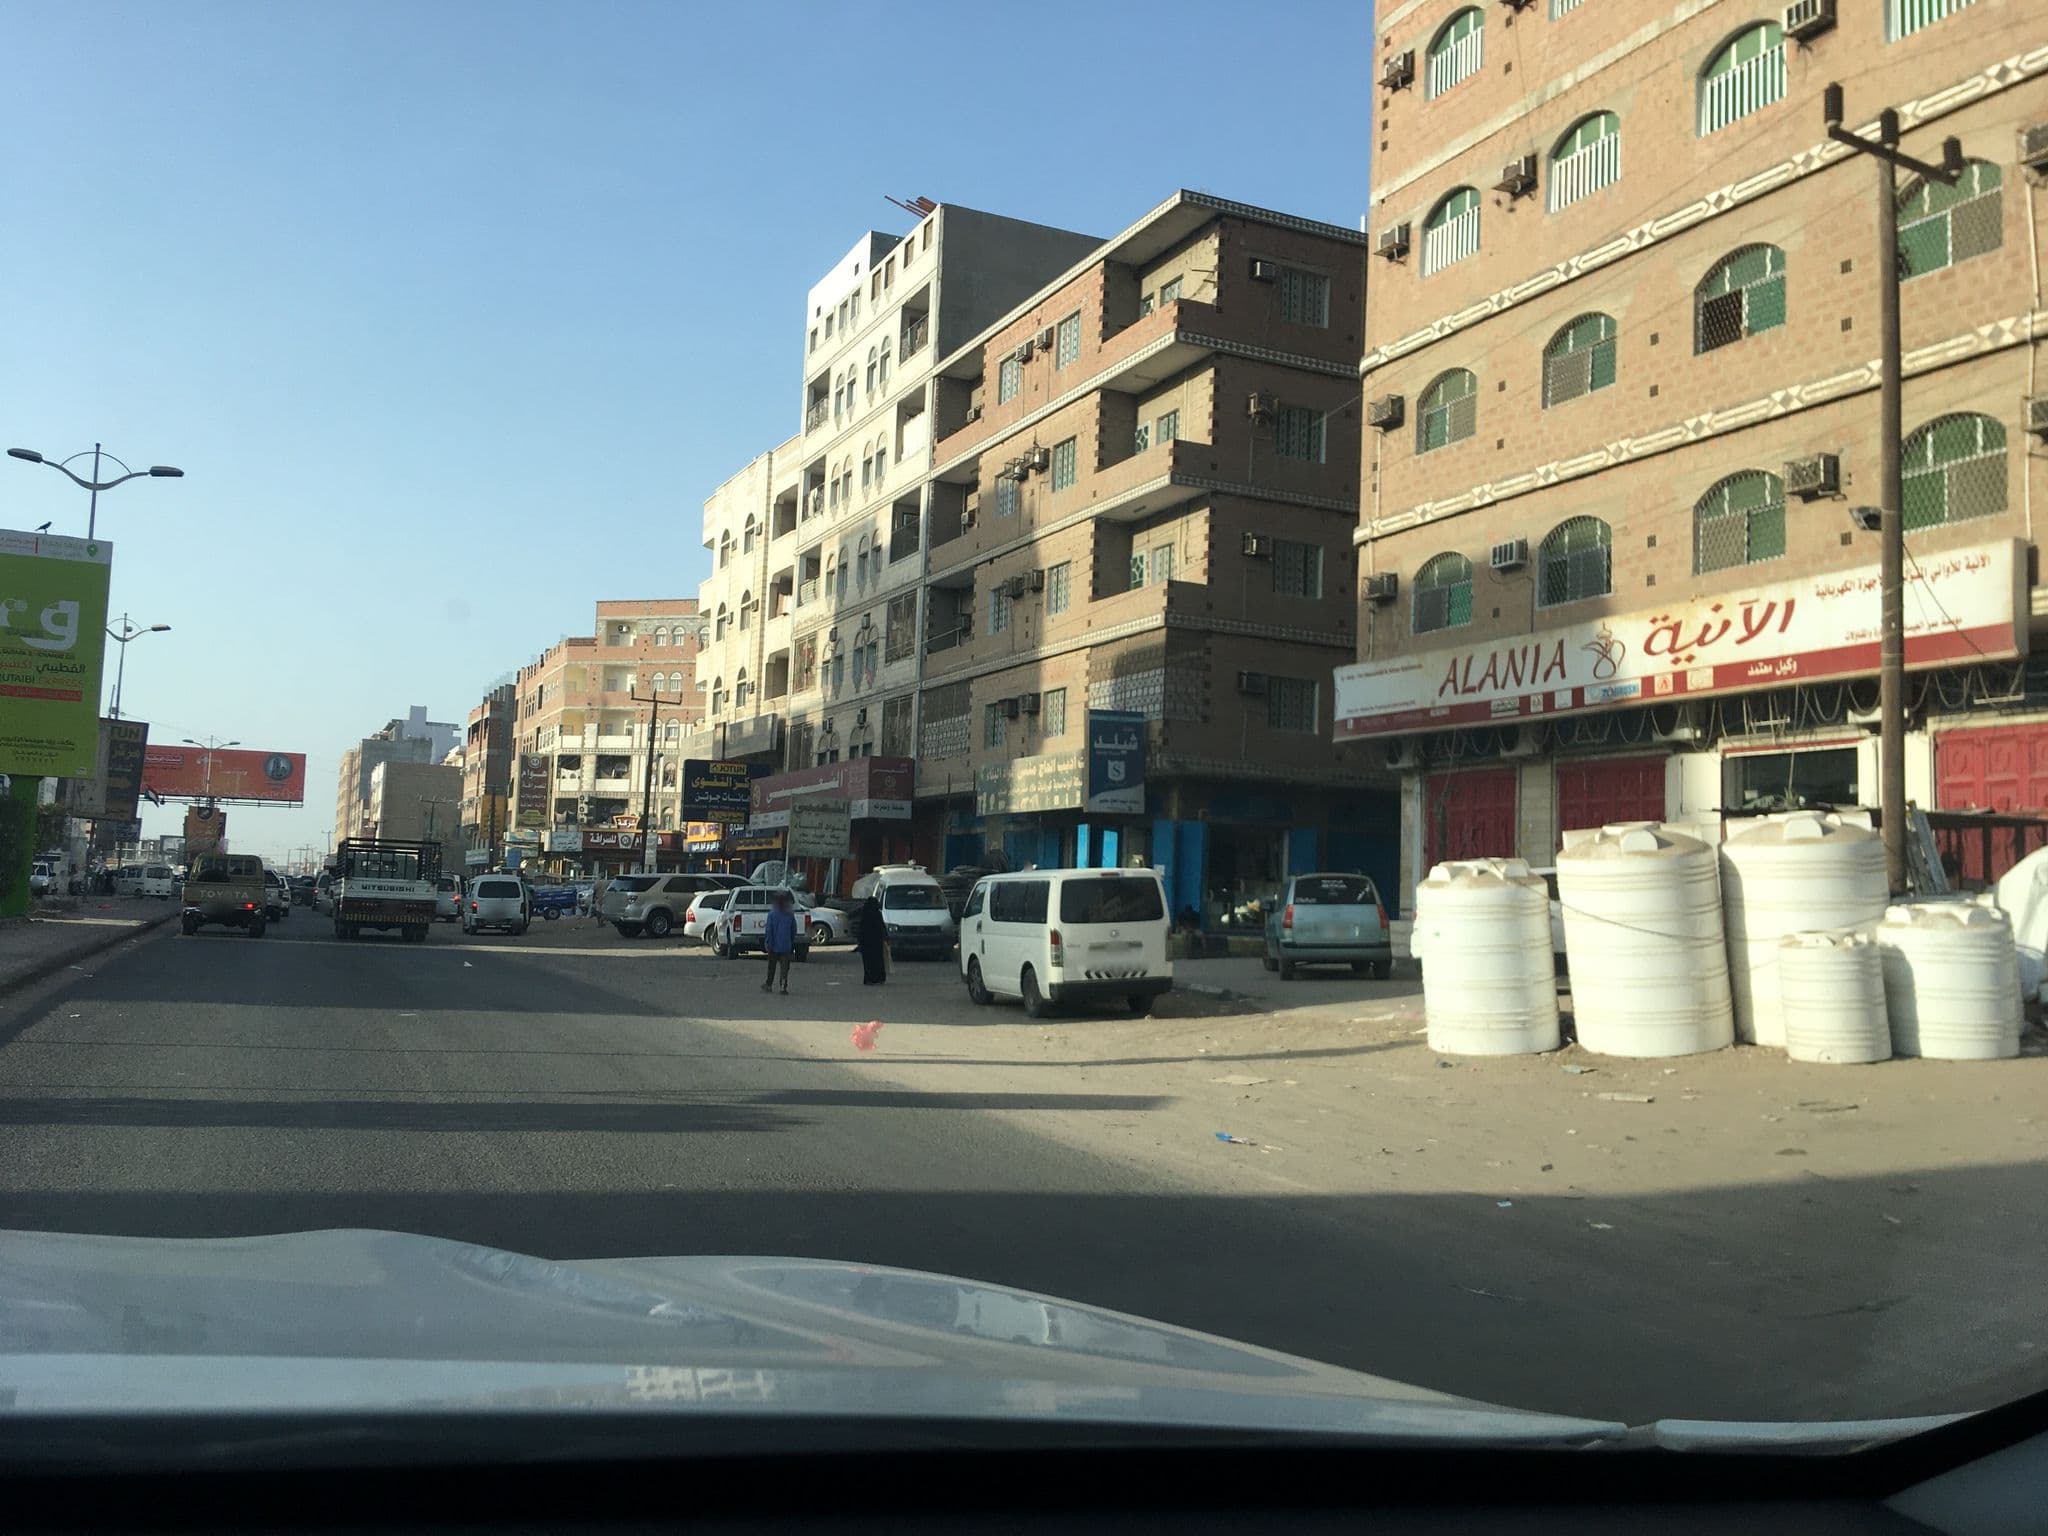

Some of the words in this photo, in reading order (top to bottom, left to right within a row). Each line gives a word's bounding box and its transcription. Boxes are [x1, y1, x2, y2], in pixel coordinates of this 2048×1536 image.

[1643, 597, 1796, 666] الآنية
[1438, 637, 1567, 698] ALANIA
[1747, 661, 1774, 677] معتمد
[1775, 658, 1798, 675] وكيل
[718, 764, 746, 774] JOTUN
[589, 832, 617, 846] للصرافة
[199, 889, 249, 899] TOYTA
[361, 884, 415, 893] MITSUBISHI
